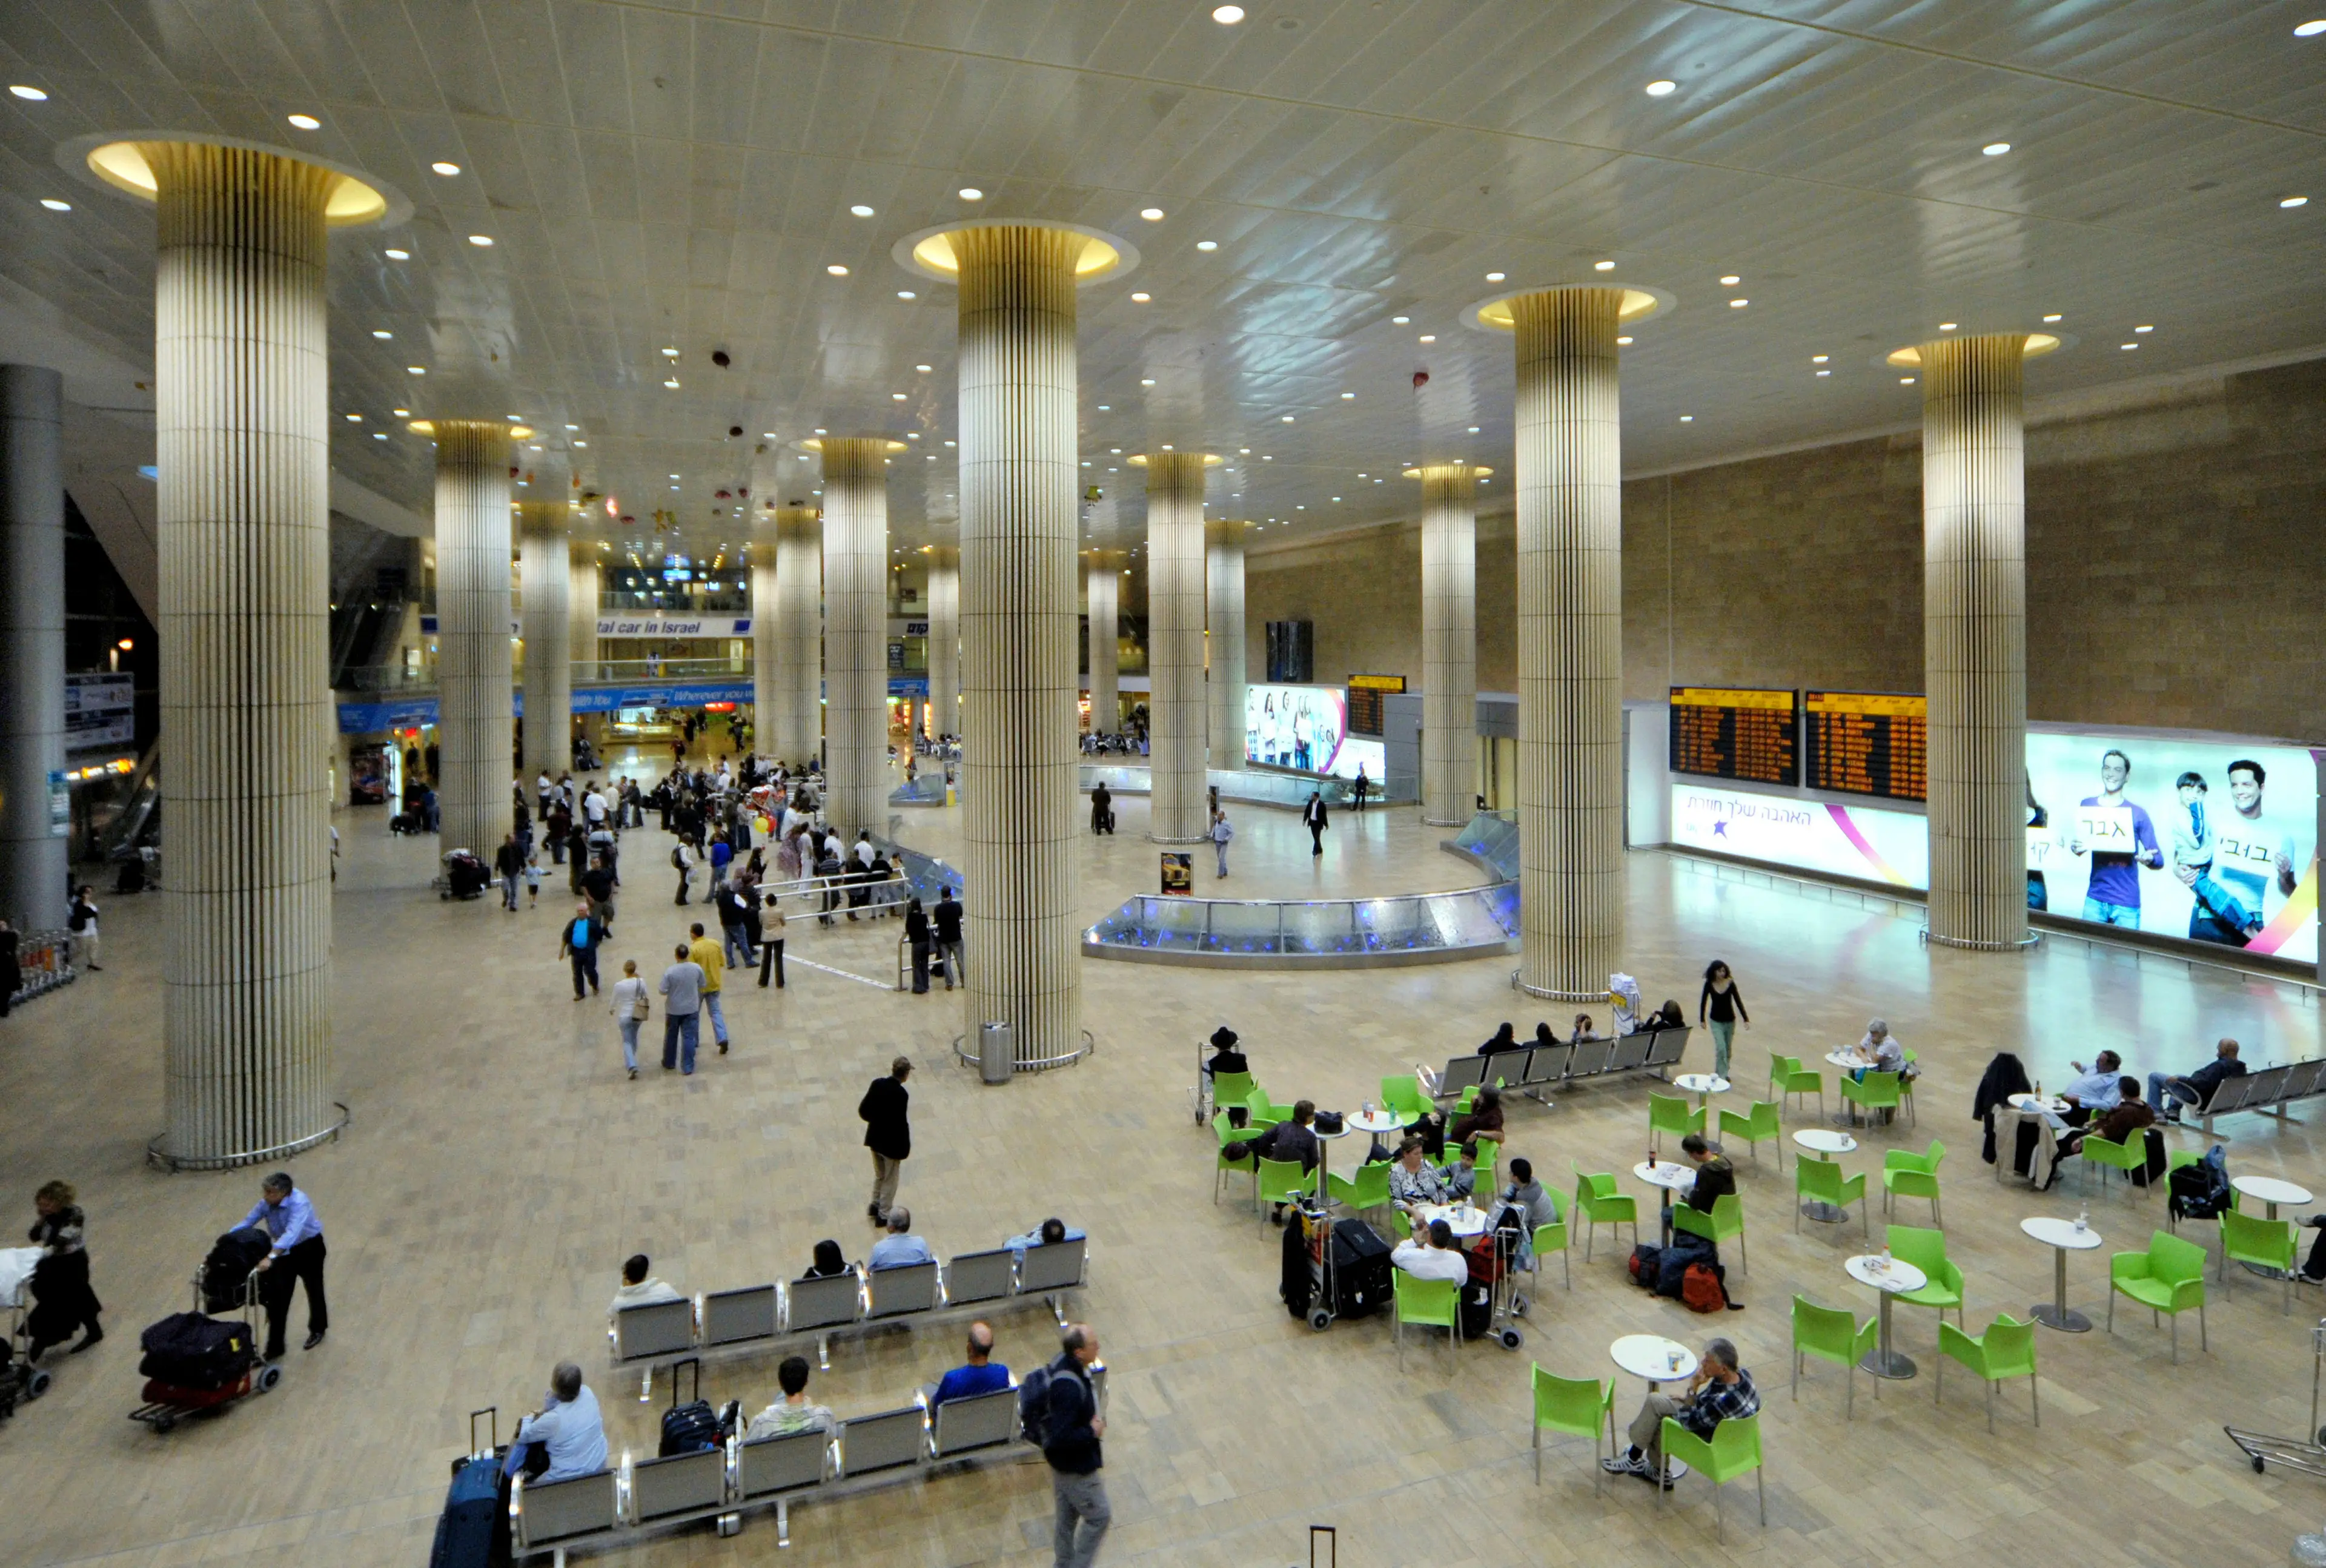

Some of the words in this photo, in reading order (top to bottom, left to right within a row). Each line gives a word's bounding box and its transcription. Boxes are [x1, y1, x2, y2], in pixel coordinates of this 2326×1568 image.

[617, 623, 641, 633] car
[644, 621, 658, 633] in
[661, 621, 700, 633] Israel
[1688, 796, 1722, 813] חוזרת
[1728, 799, 1756, 819] שלך
[1761, 806, 1811, 825] האהבה
[2082, 820, 2126, 838] גבר
[2220, 838, 2271, 862] בובי
